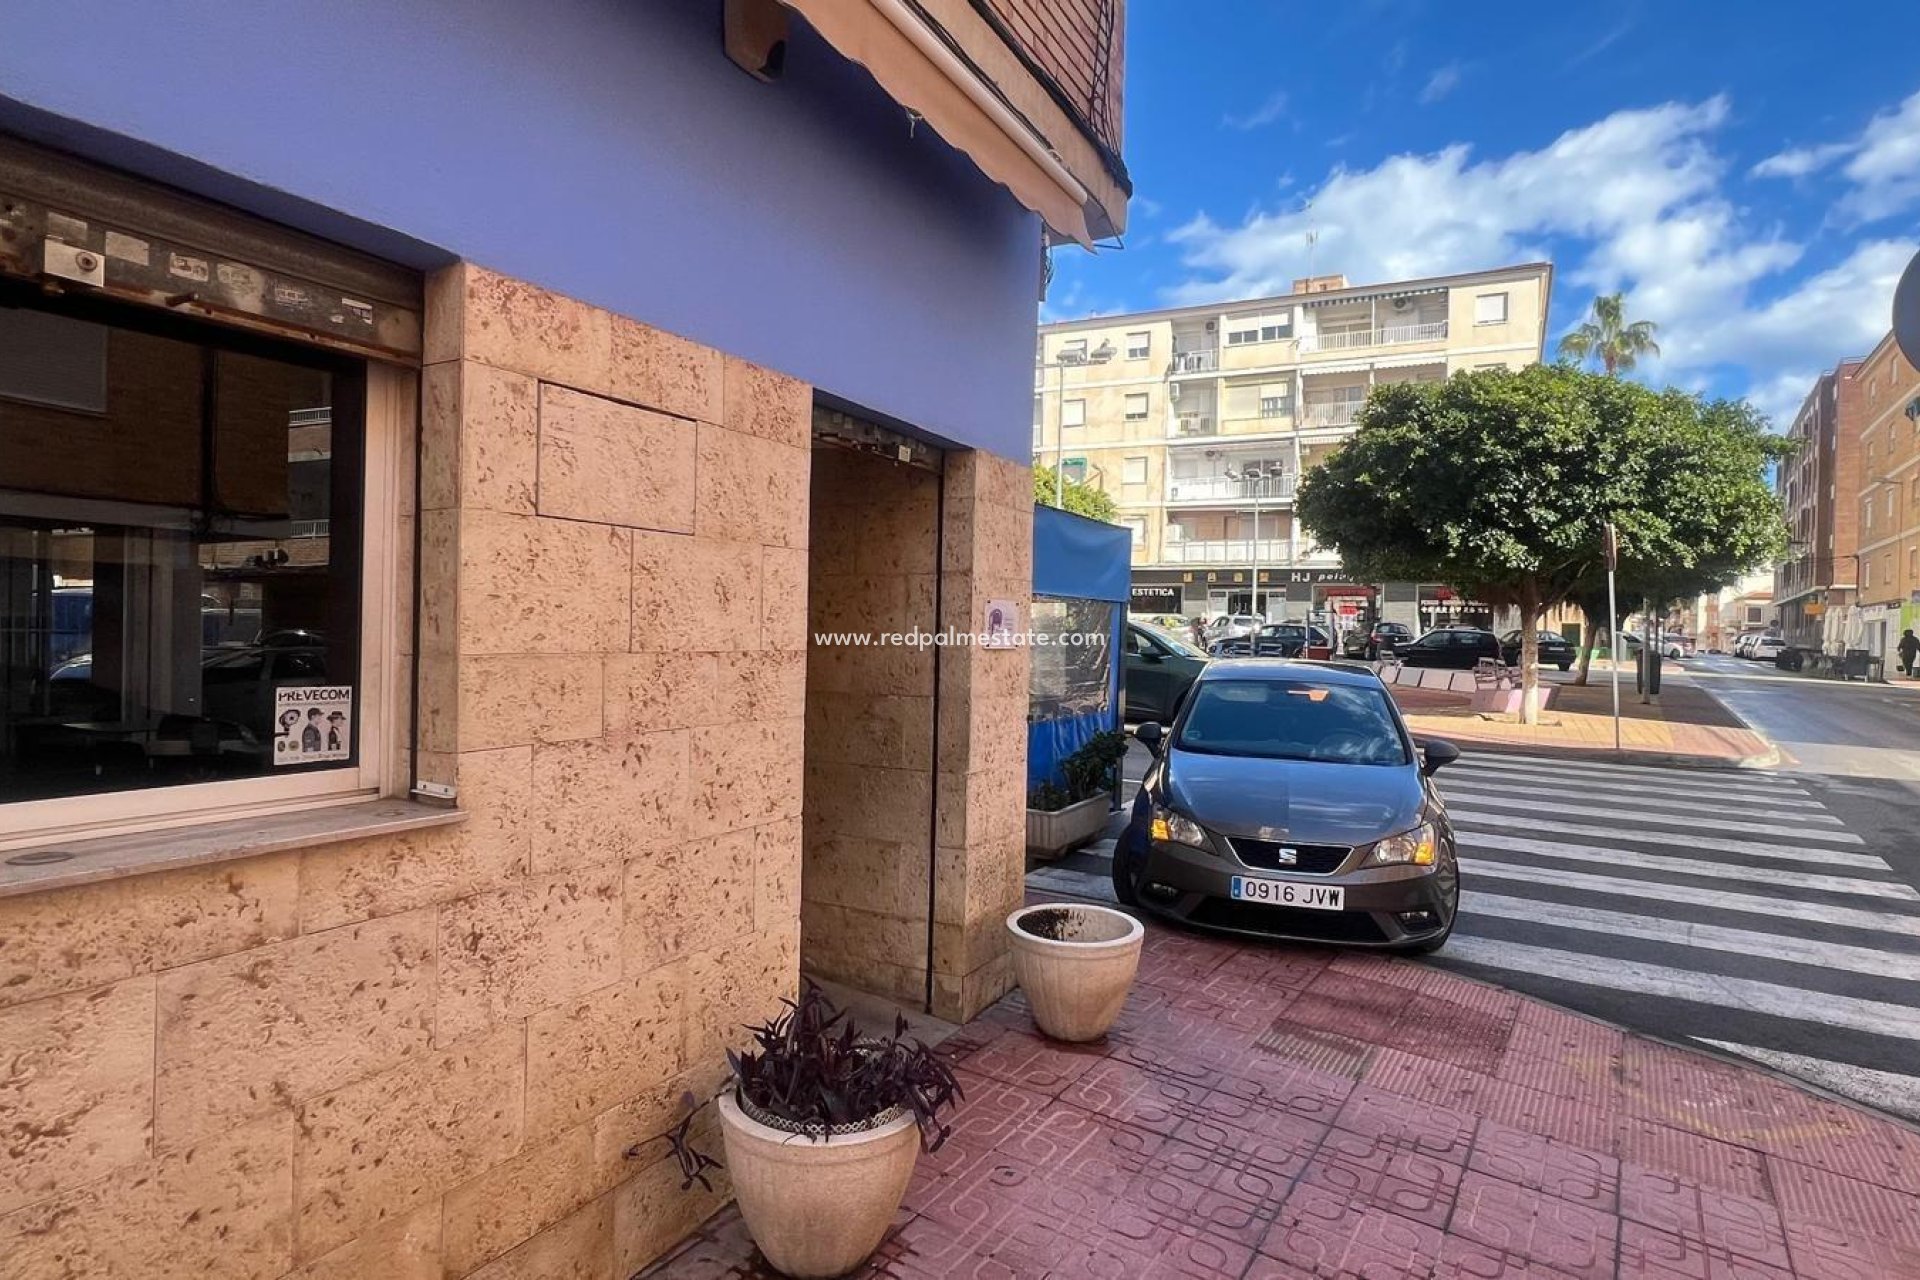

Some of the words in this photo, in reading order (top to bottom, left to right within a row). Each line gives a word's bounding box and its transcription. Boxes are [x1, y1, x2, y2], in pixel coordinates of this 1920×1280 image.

[278, 689, 350, 702] PREVECOM
[1245, 881, 1295, 902] 0916
[1302, 888, 1340, 906] JVW
